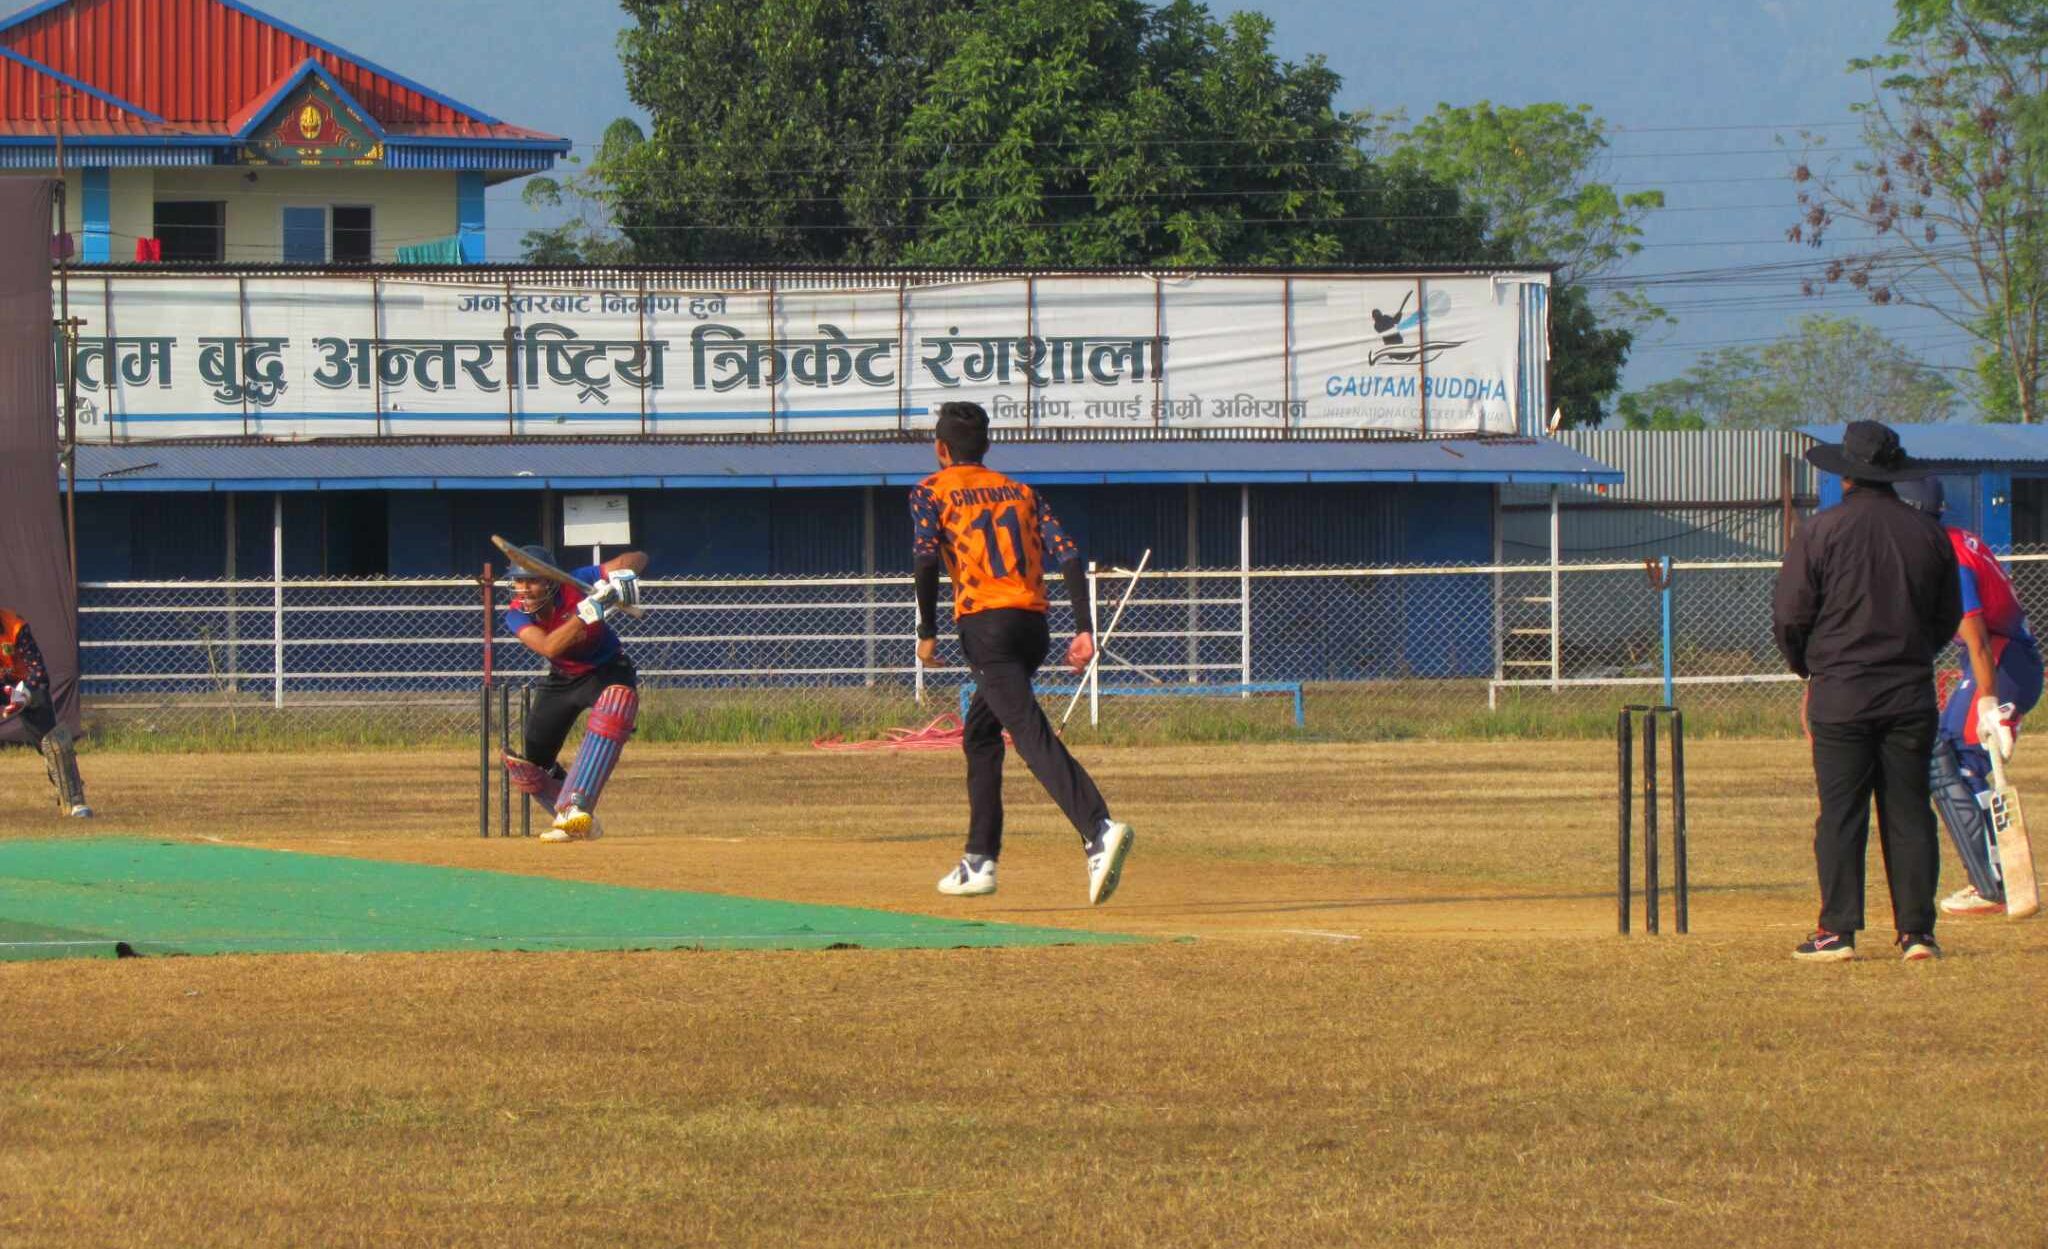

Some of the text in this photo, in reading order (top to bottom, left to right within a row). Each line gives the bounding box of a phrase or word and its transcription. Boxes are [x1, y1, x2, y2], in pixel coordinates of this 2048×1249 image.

[197, 336, 290, 406] बुद्ध
[689, 323, 901, 393] क्रिकेट
[920, 325, 1170, 388] रंगशाला
[1325, 375, 1508, 401] GAUTAM BUDDHA
[971, 504, 1027, 579] 11
